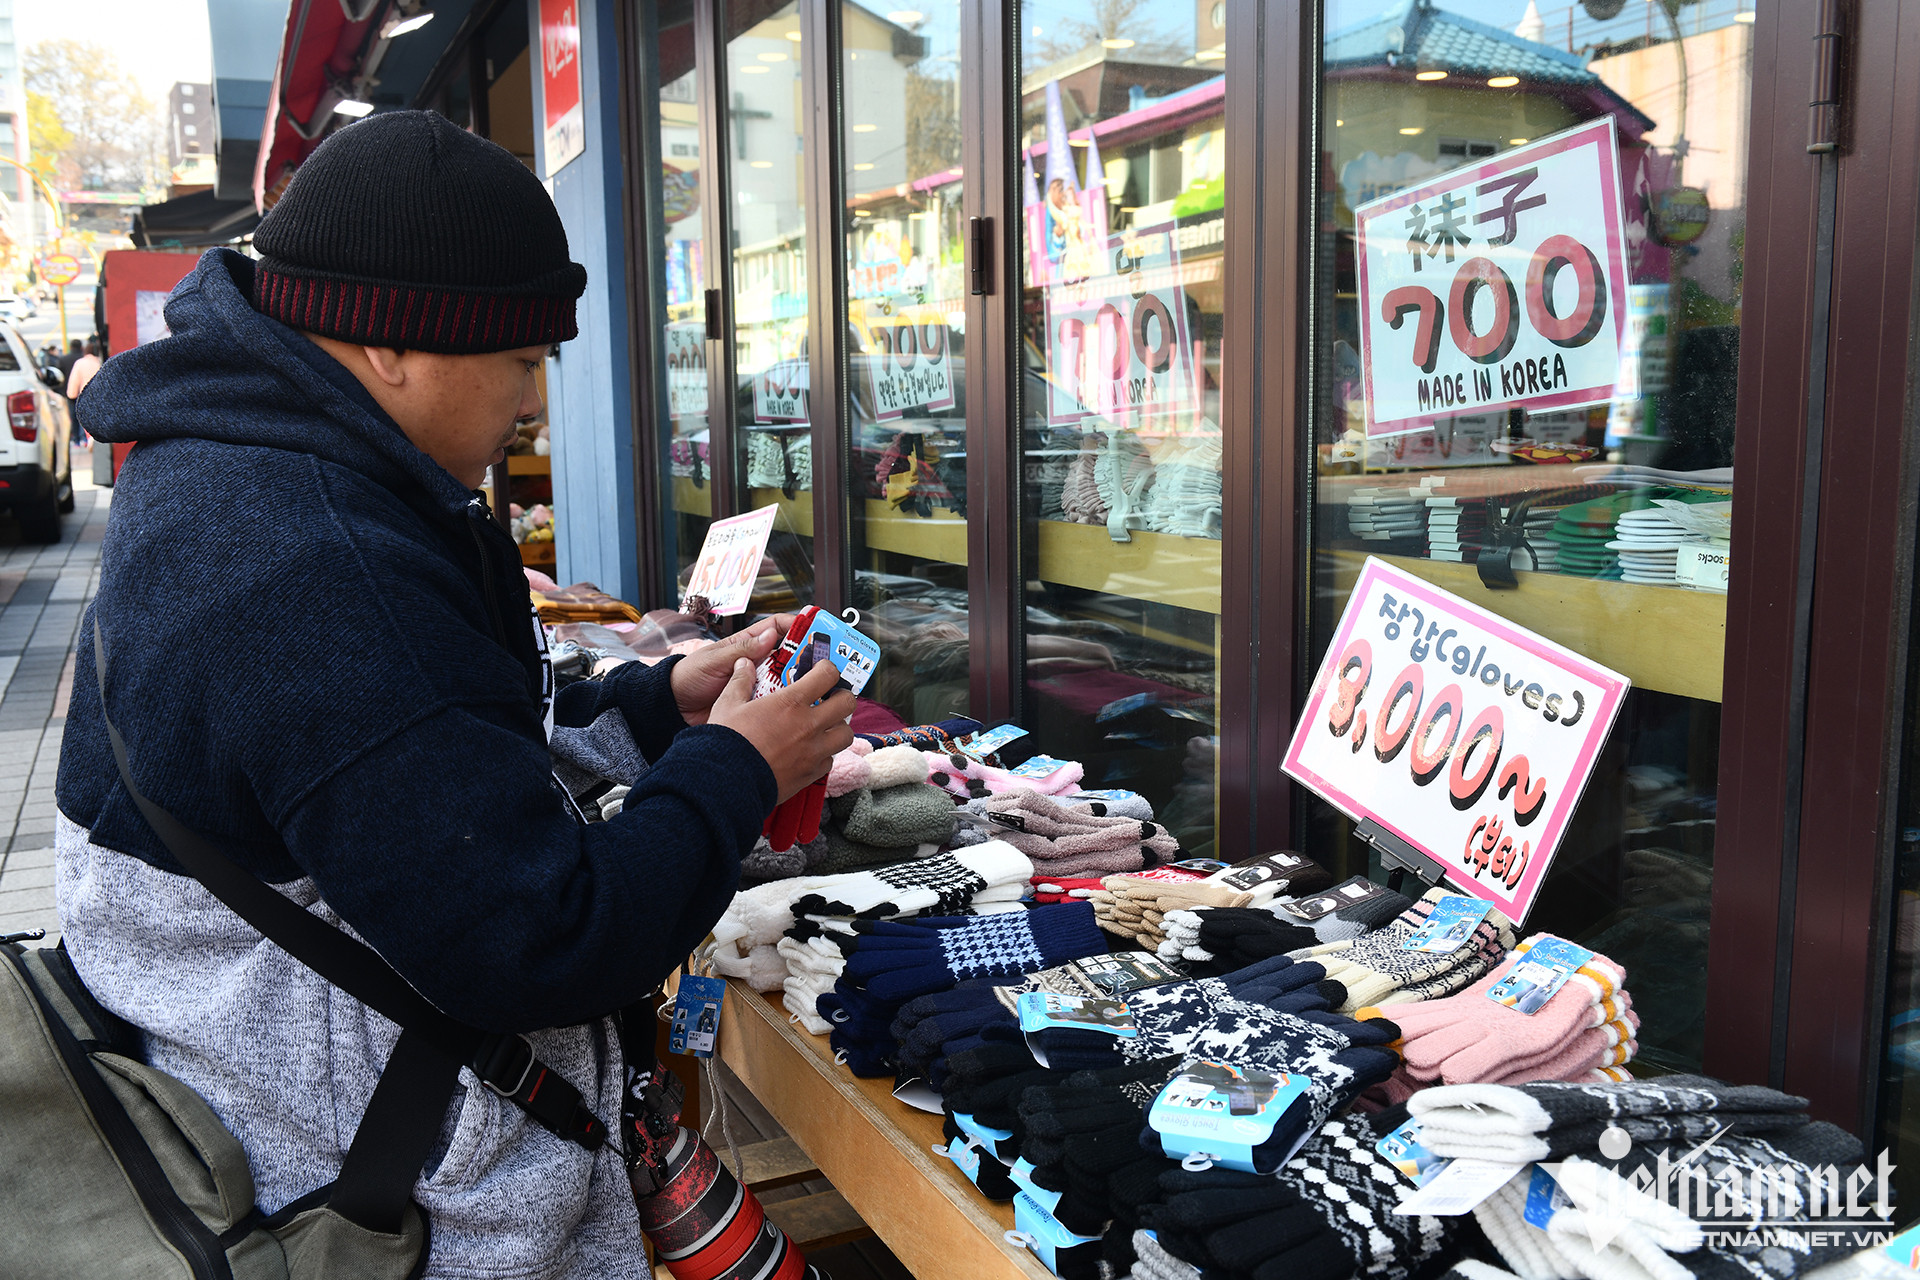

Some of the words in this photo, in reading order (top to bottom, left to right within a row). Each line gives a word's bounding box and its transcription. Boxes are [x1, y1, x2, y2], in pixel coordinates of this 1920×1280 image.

[1405, 167, 1547, 272] 袜子
[1382, 234, 1607, 374] 700
[870, 309, 945, 377] 700
[1058, 293, 1178, 385] 700
[1418, 372, 1467, 412] MADE
[1473, 368, 1492, 401] IN
[1502, 353, 1568, 398] KOREA
[692, 545, 757, 593] 15,000
[845, 629, 860, 643] Touch
[860, 639, 877, 653] Gloves
[1379, 593, 1585, 727] 장갑(gloves)
[1463, 814, 1530, 891] (부터)
[1021, 1194, 1039, 1211] Gloves
[1036, 1206, 1052, 1224] Touch
